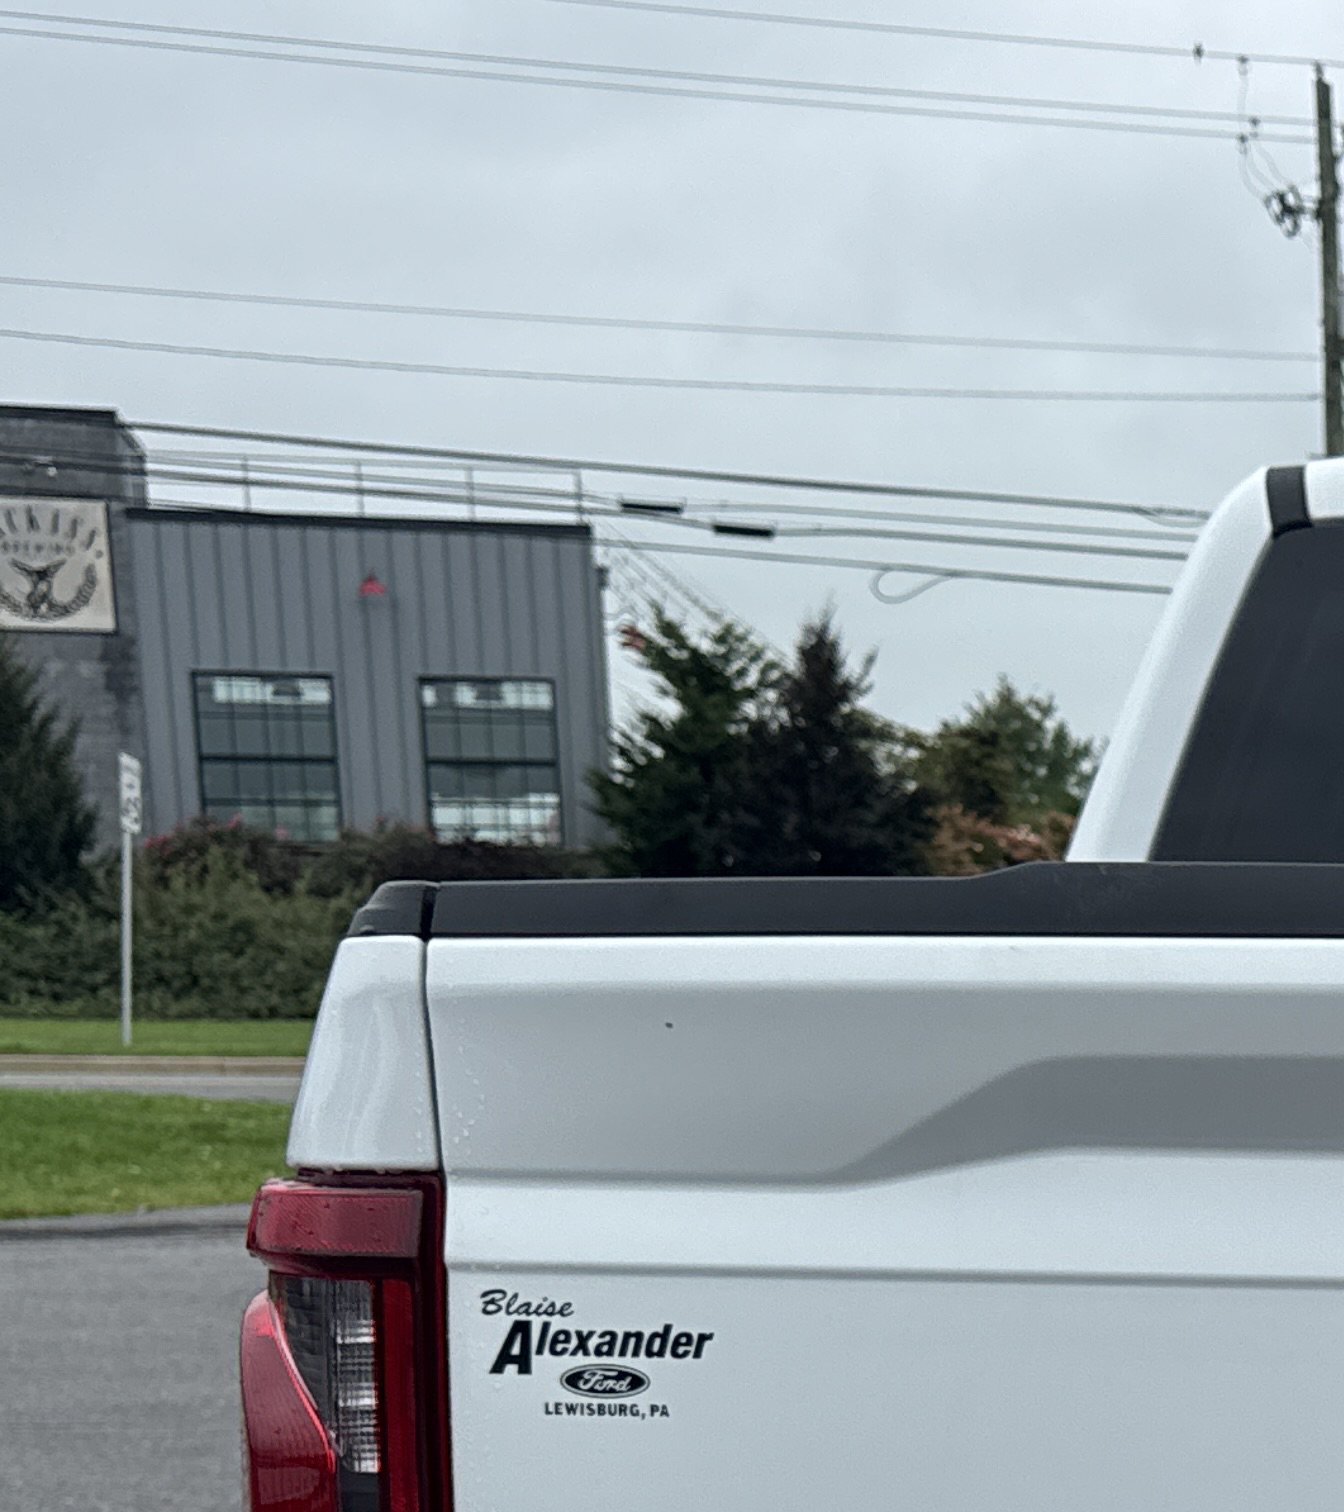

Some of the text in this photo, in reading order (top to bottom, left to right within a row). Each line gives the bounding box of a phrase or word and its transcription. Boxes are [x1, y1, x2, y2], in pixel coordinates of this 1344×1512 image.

[480, 1289, 574, 1317] Blaise
[489, 1320, 714, 1374] Alexander
[577, 1369, 631, 1392] Ford
[545, 1402, 670, 1420] LEWISBURG, PA
